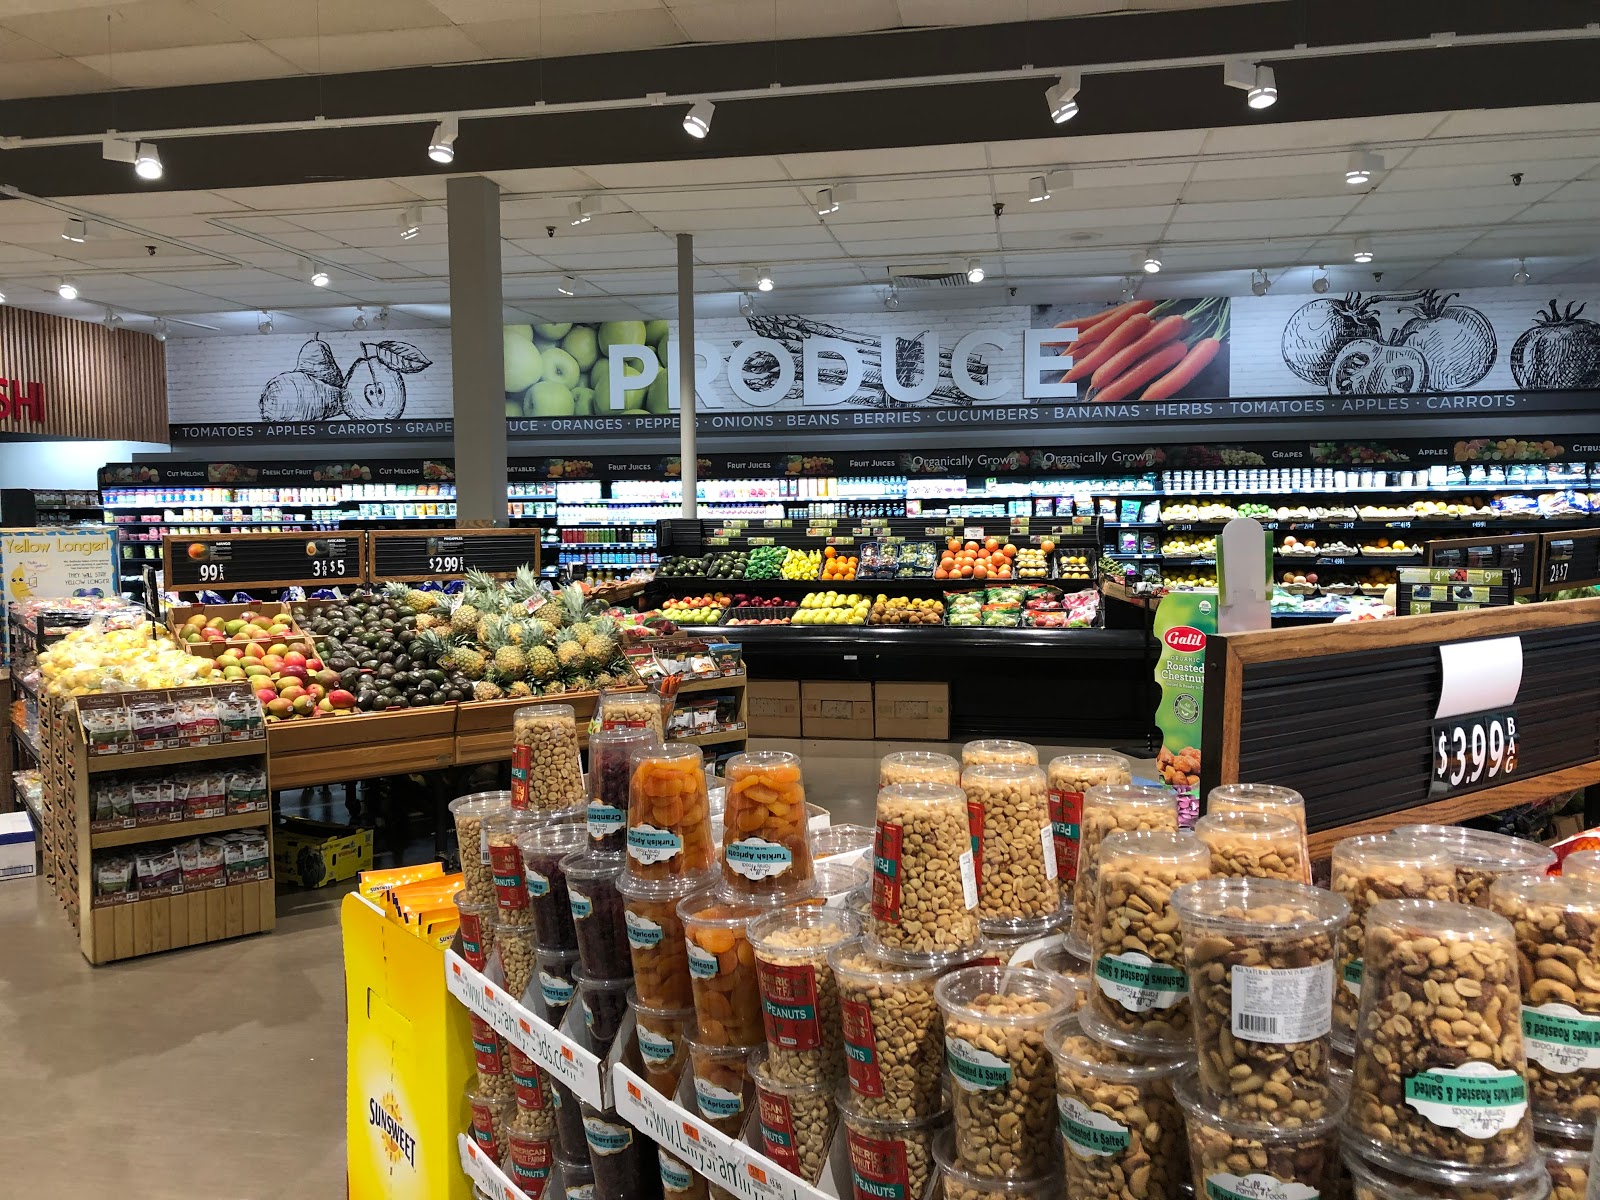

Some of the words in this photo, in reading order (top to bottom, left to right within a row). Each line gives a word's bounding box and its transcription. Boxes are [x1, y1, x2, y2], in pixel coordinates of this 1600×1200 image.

[608, 327, 1078, 411] PRODUCE
[551, 419, 622, 431] ORANGES
[712, 415, 773, 428] ONIONS
[786, 414, 839, 426] BEANS
[853, 411, 921, 424] BERRIES
[936, 407, 1039, 423] CUCUMBERS
[1054, 405, 1140, 419] BANANAS
[1155, 403, 1213, 416] HERBS
[1230, 400, 1325, 414] TOMATOES
[1342, 398, 1409, 411] APPLES
[1426, 395, 1515, 408] CARROTS
[182, 426, 254, 438] TOMATOES
[267, 425, 316, 436] APPLES
[328, 423, 393, 435] CARROTS
[912, 455, 976, 470] Organically
[977, 455, 1017, 466] Grown
[1044, 451, 1108, 466] Organically
[1112, 451, 1153, 463] Grown
[6, 539, 51, 554] Yellow
[57, 537, 110, 556] Longer!
[313, 560, 321, 577] 3
[429, 556, 459, 573] $2.99
[1167, 631, 1203, 647] Galil
[1170, 655, 1201, 664] ORGANIC
[1166, 660, 1205, 675] Roasted
[1161, 670, 1205, 684] Chestnut
[1438, 720, 1504, 786] $3.99
[1505, 717, 1516, 774] BAG
[647, 839, 675, 848] Turkish
[727, 849, 755, 860] Apricots
[757, 853, 787, 861] Turkish
[632, 930, 660, 940] Apricots
[1114, 967, 1120, 979] &
[1120, 969, 1150, 986] Roasted
[1151, 975, 1185, 989] Cashews
[1116, 984, 1133, 996] Foods
[1138, 988, 1159, 999] Family
[1127, 991, 1157, 1008] Lilly's
[766, 1002, 807, 1020] PEANUTS
[1526, 1021, 1532, 1035] &
[1534, 1023, 1570, 1043] Roasted
[1572, 1029, 1592, 1045] Nuts
[644, 1043, 671, 1055] Apricots
[1531, 1040, 1556, 1053] Foods
[1562, 1046, 1588, 1058] Family
[1548, 1049, 1585, 1067] Lilly's
[978, 1068, 984, 1079] &
[985, 1069, 1007, 1082] Salted
[1414, 1082, 1443, 1100] Salted
[1446, 1086, 1453, 1102] &
[1456, 1087, 1492, 1104] Roasted
[1494, 1088, 1510, 1103] Nuts
[707, 1100, 739, 1112] Apricots
[1451, 1107, 1477, 1117] Foods
[1483, 1108, 1506, 1119] Family
[1470, 1113, 1504, 1131] Lilly's
[369, 1097, 417, 1171] SUNSWEET
[1093, 1132, 1099, 1144] &
[1100, 1133, 1125, 1147] Salted
[515, 1167, 545, 1179] PEANUTS
[855, 1173, 897, 1199] PEANUTS
[1235, 1185, 1259, 1200] Family
[1265, 1190, 1288, 1200] Foods
[1237, 1178, 1272, 1197] Lilly's
